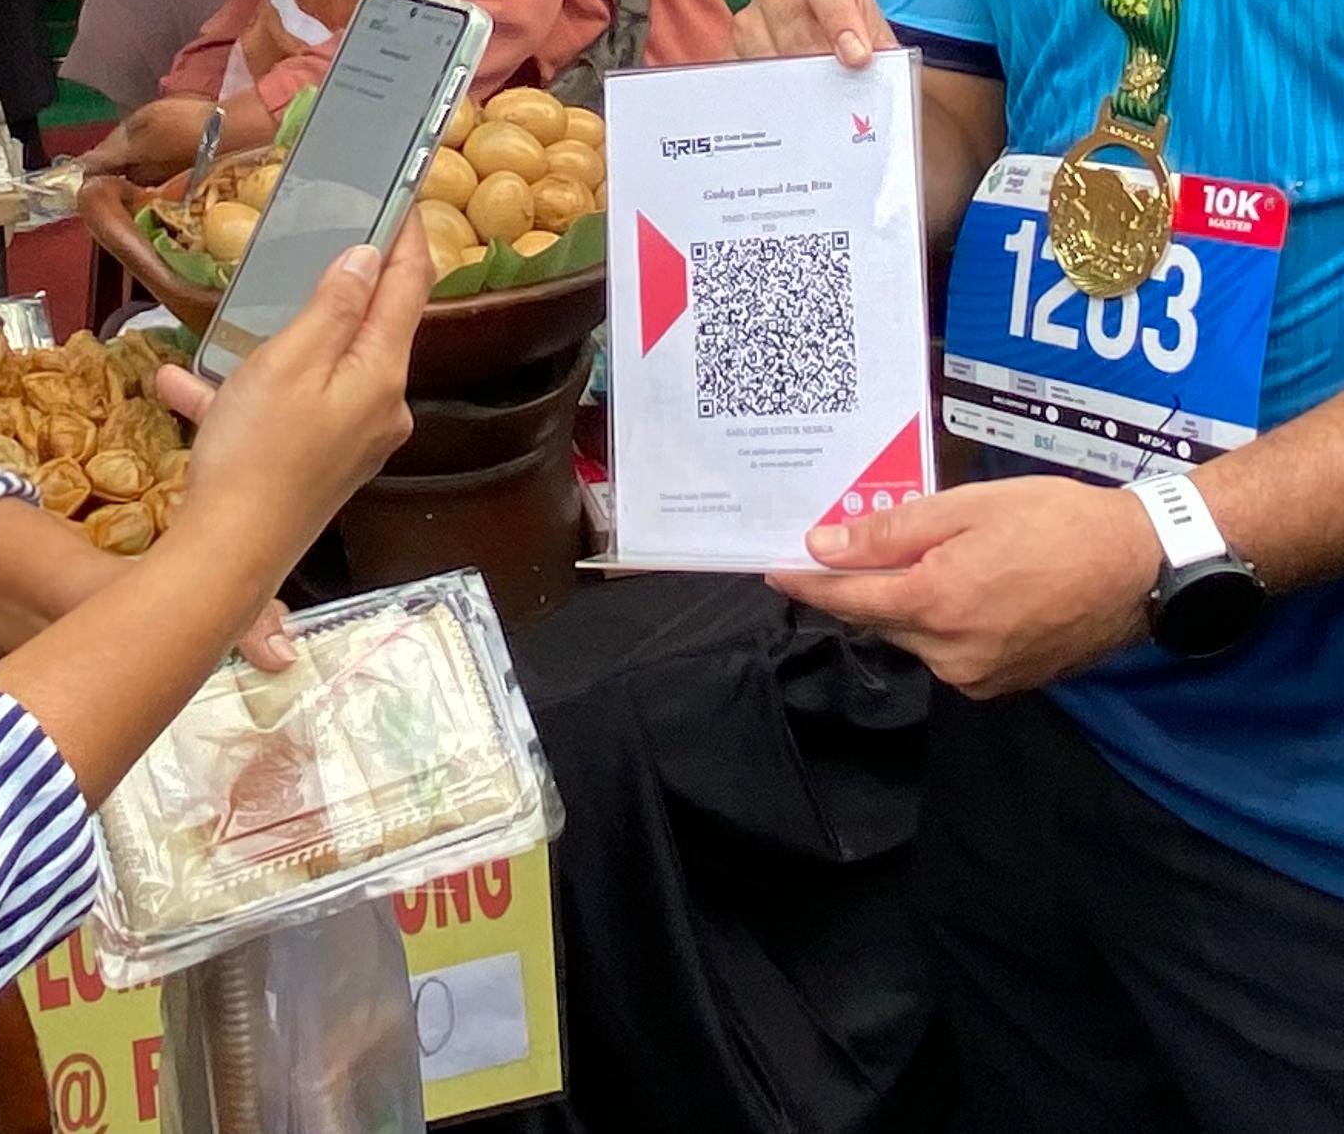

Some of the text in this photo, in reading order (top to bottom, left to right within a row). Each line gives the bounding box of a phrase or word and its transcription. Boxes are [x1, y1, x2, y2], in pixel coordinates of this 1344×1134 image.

[662, 137, 711, 160] QRIS
[1203, 185, 1264, 221] 10K
[1207, 217, 1253, 233] MASTER
